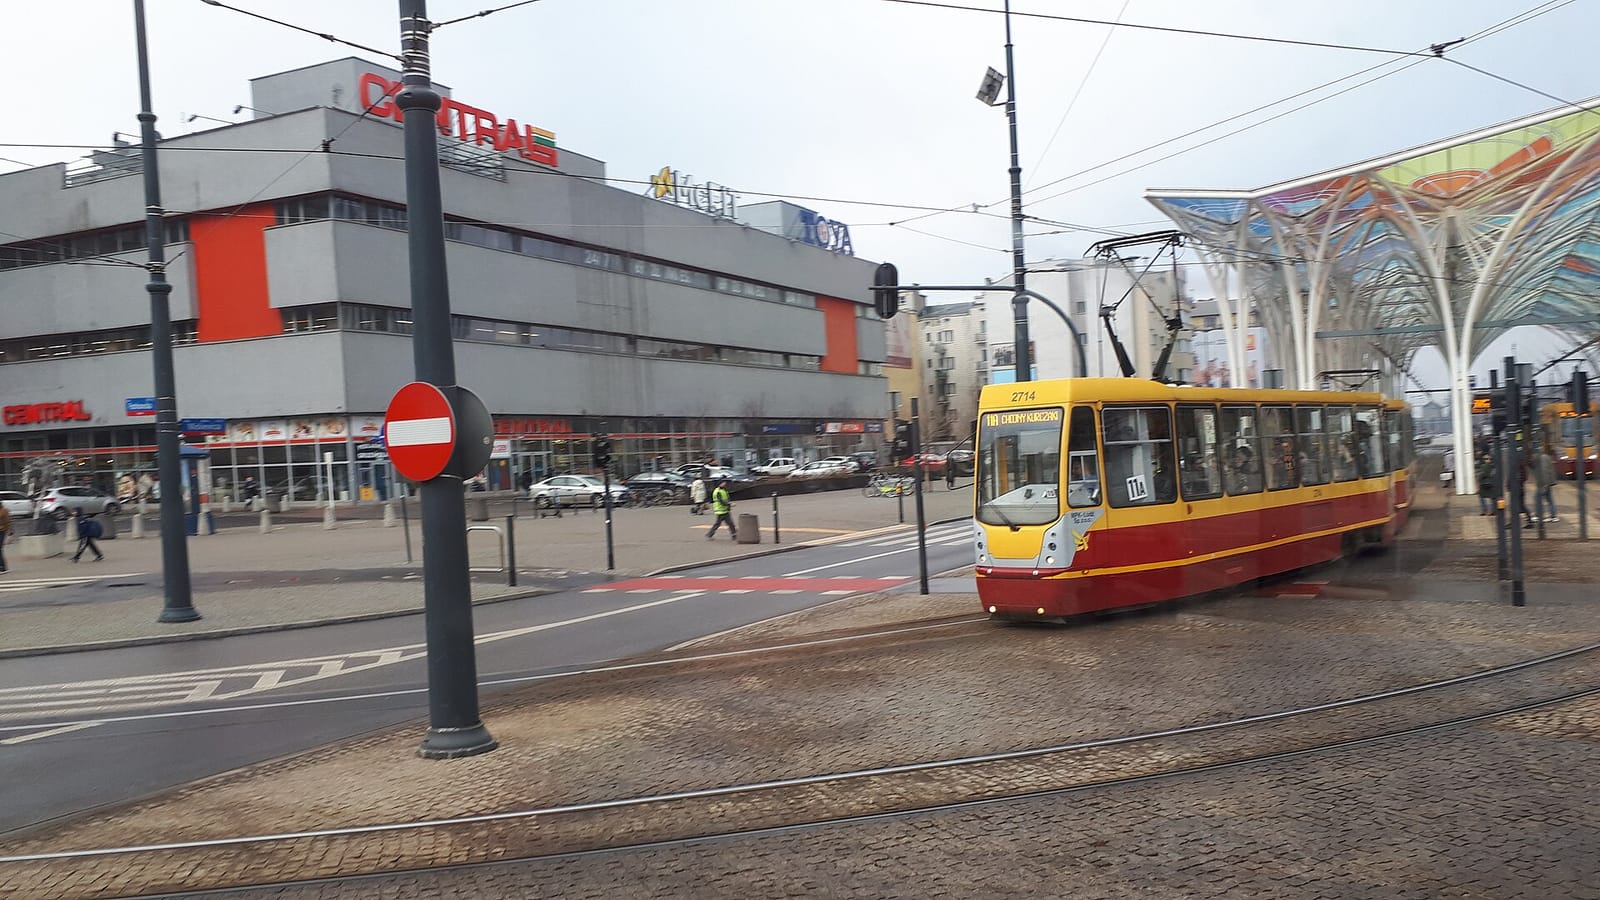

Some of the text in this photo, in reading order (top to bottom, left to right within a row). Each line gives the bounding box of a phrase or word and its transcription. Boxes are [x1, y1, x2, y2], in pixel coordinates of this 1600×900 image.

[799, 209, 854, 256] TOYA
[1011, 391, 1037, 402] 2714
[3, 401, 92, 426] CENTRAL
[986, 413, 999, 427] 11A
[1128, 478, 1146, 498] 11A
